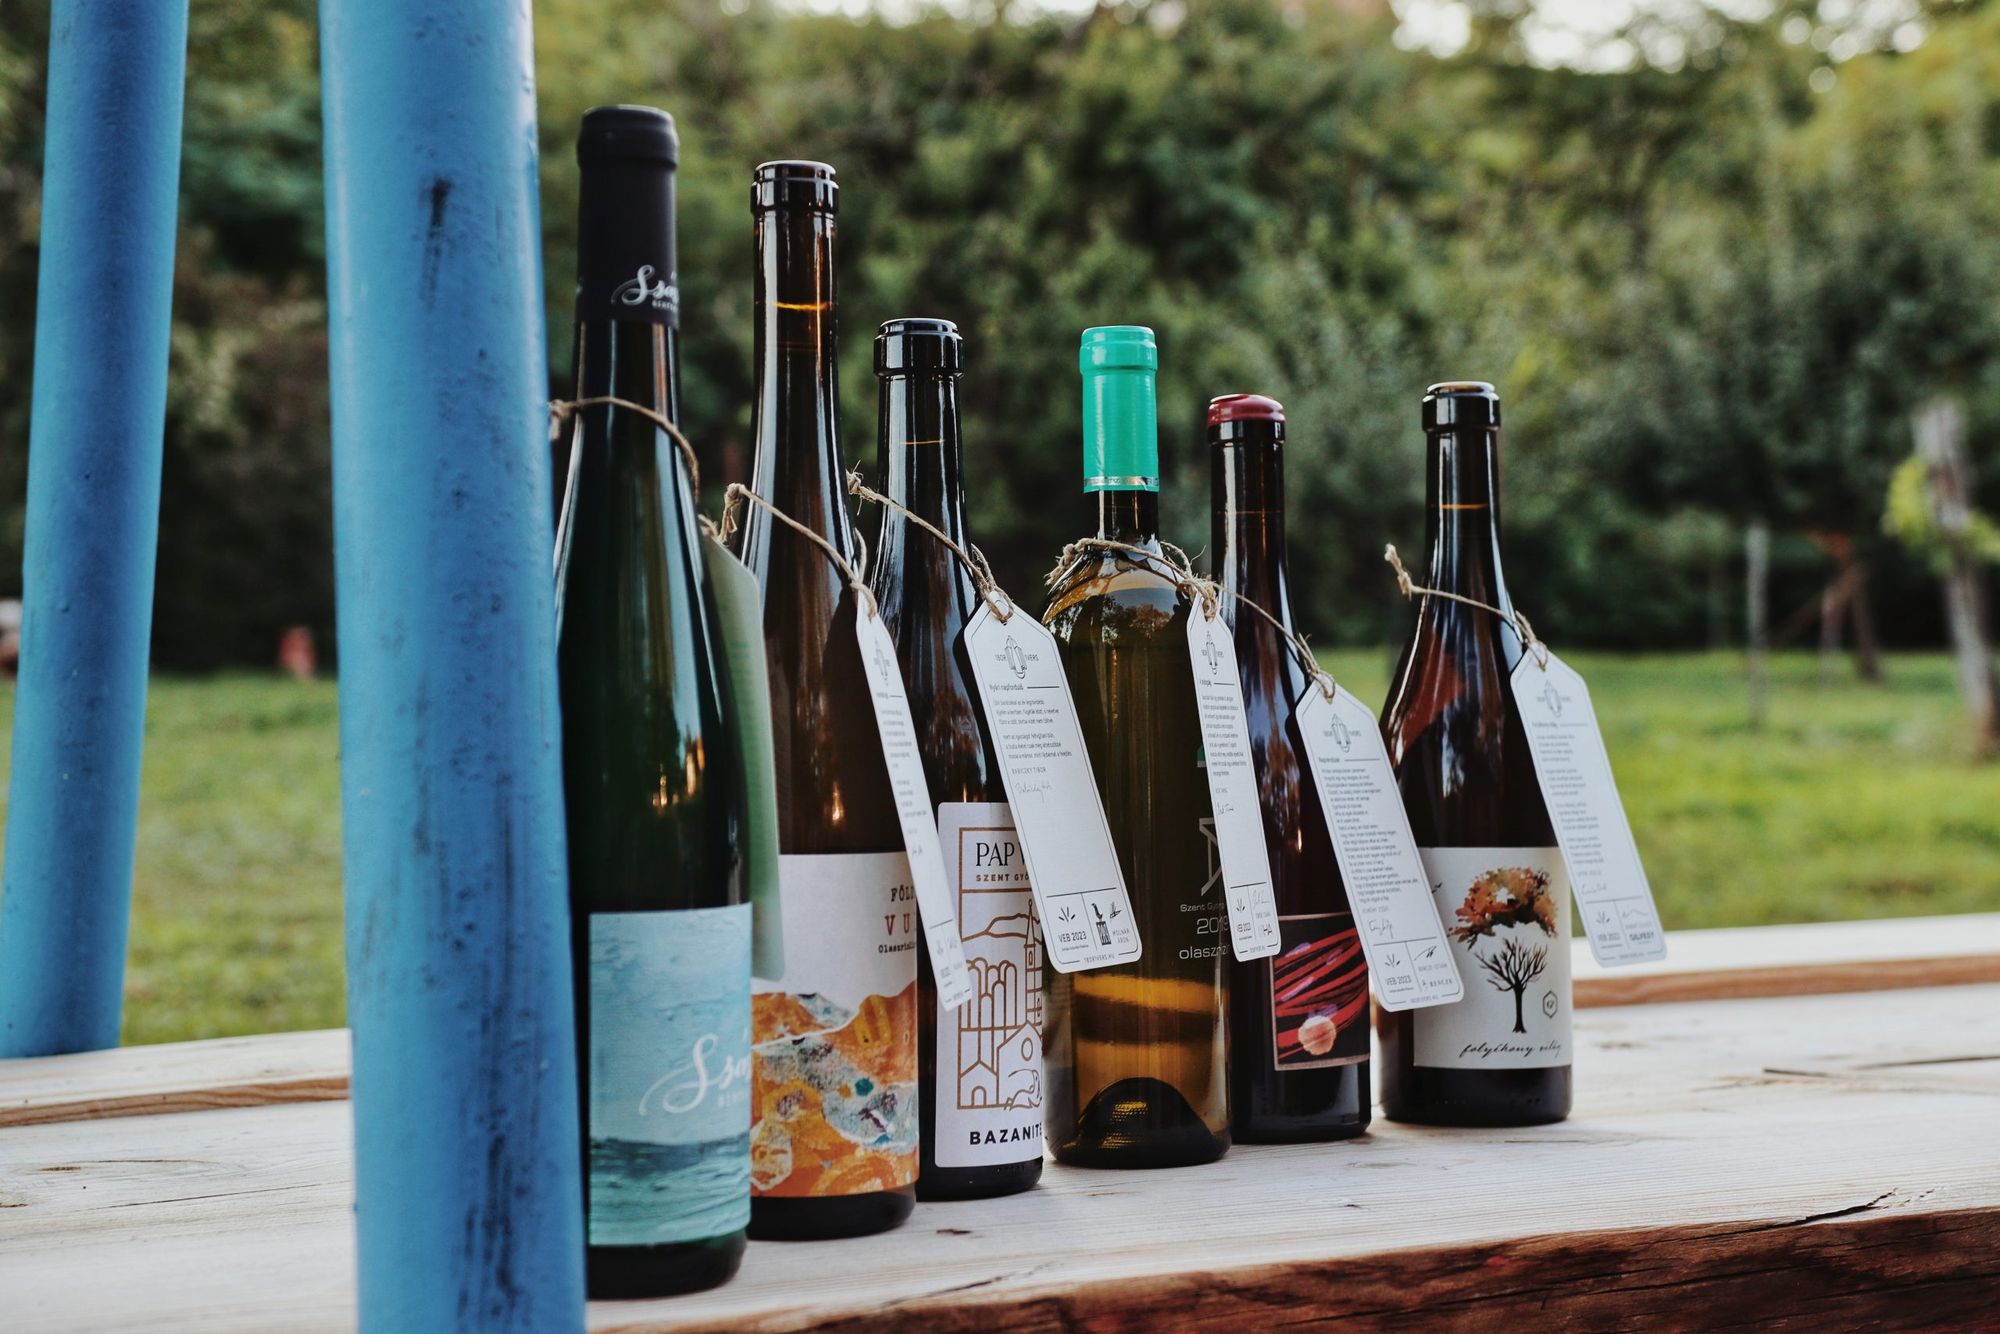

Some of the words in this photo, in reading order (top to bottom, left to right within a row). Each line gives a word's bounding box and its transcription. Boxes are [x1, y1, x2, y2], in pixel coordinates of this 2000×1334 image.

[975, 842, 1015, 867] PAP
[975, 873, 1010, 882] SZENT
[1057, 932, 1071, 943] VEB
[1071, 930, 1087, 941] 2023
